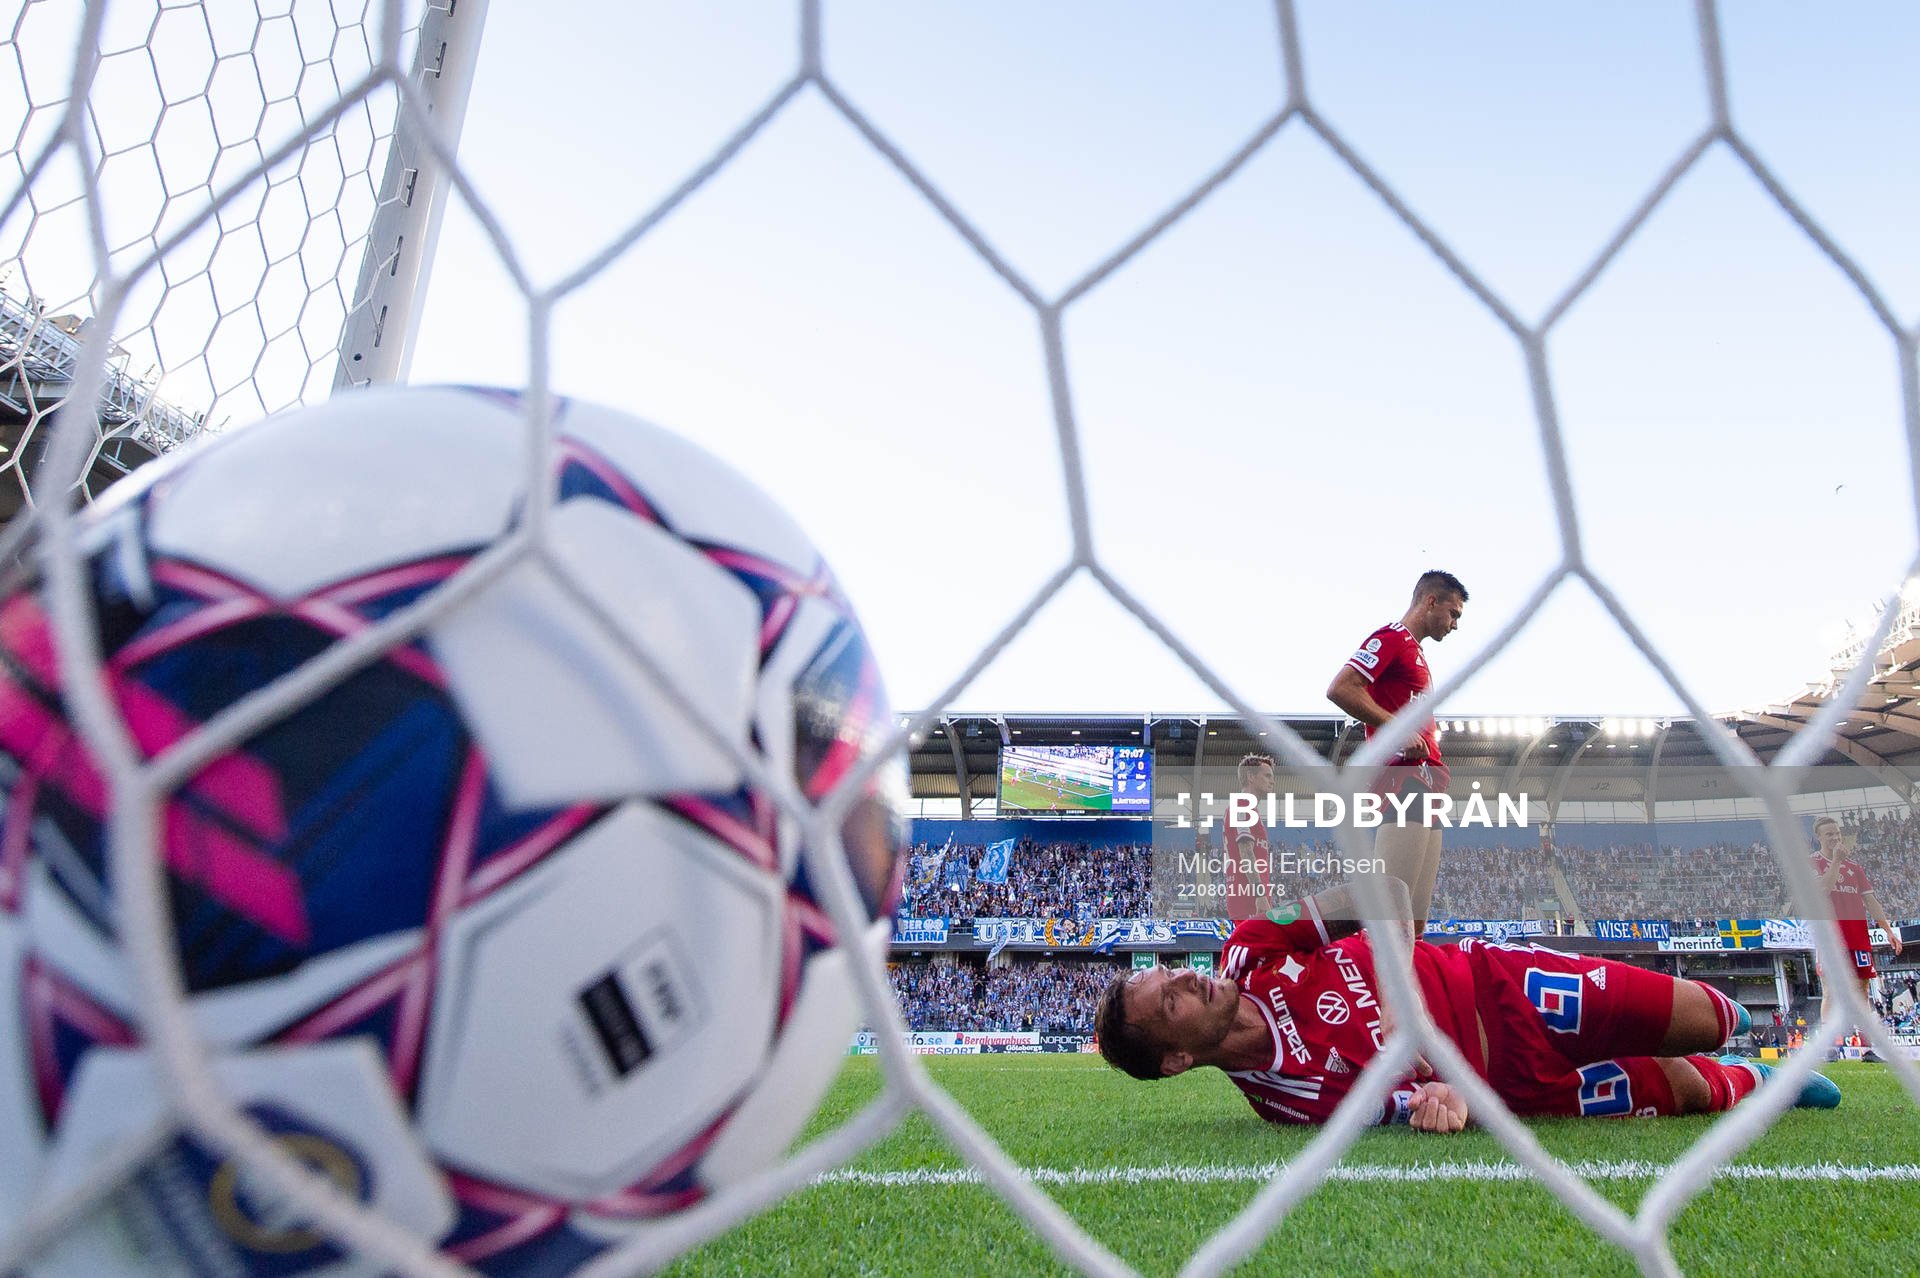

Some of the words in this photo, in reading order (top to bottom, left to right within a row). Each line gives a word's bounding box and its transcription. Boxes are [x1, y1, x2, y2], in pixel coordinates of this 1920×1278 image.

[1119, 749, 1144, 758] 29:07
[1137, 761, 1145, 770] 0
[1598, 921, 1631, 938] WISE
[1642, 921, 1669, 939] MEN
[1268, 986, 1312, 1065] stadium
